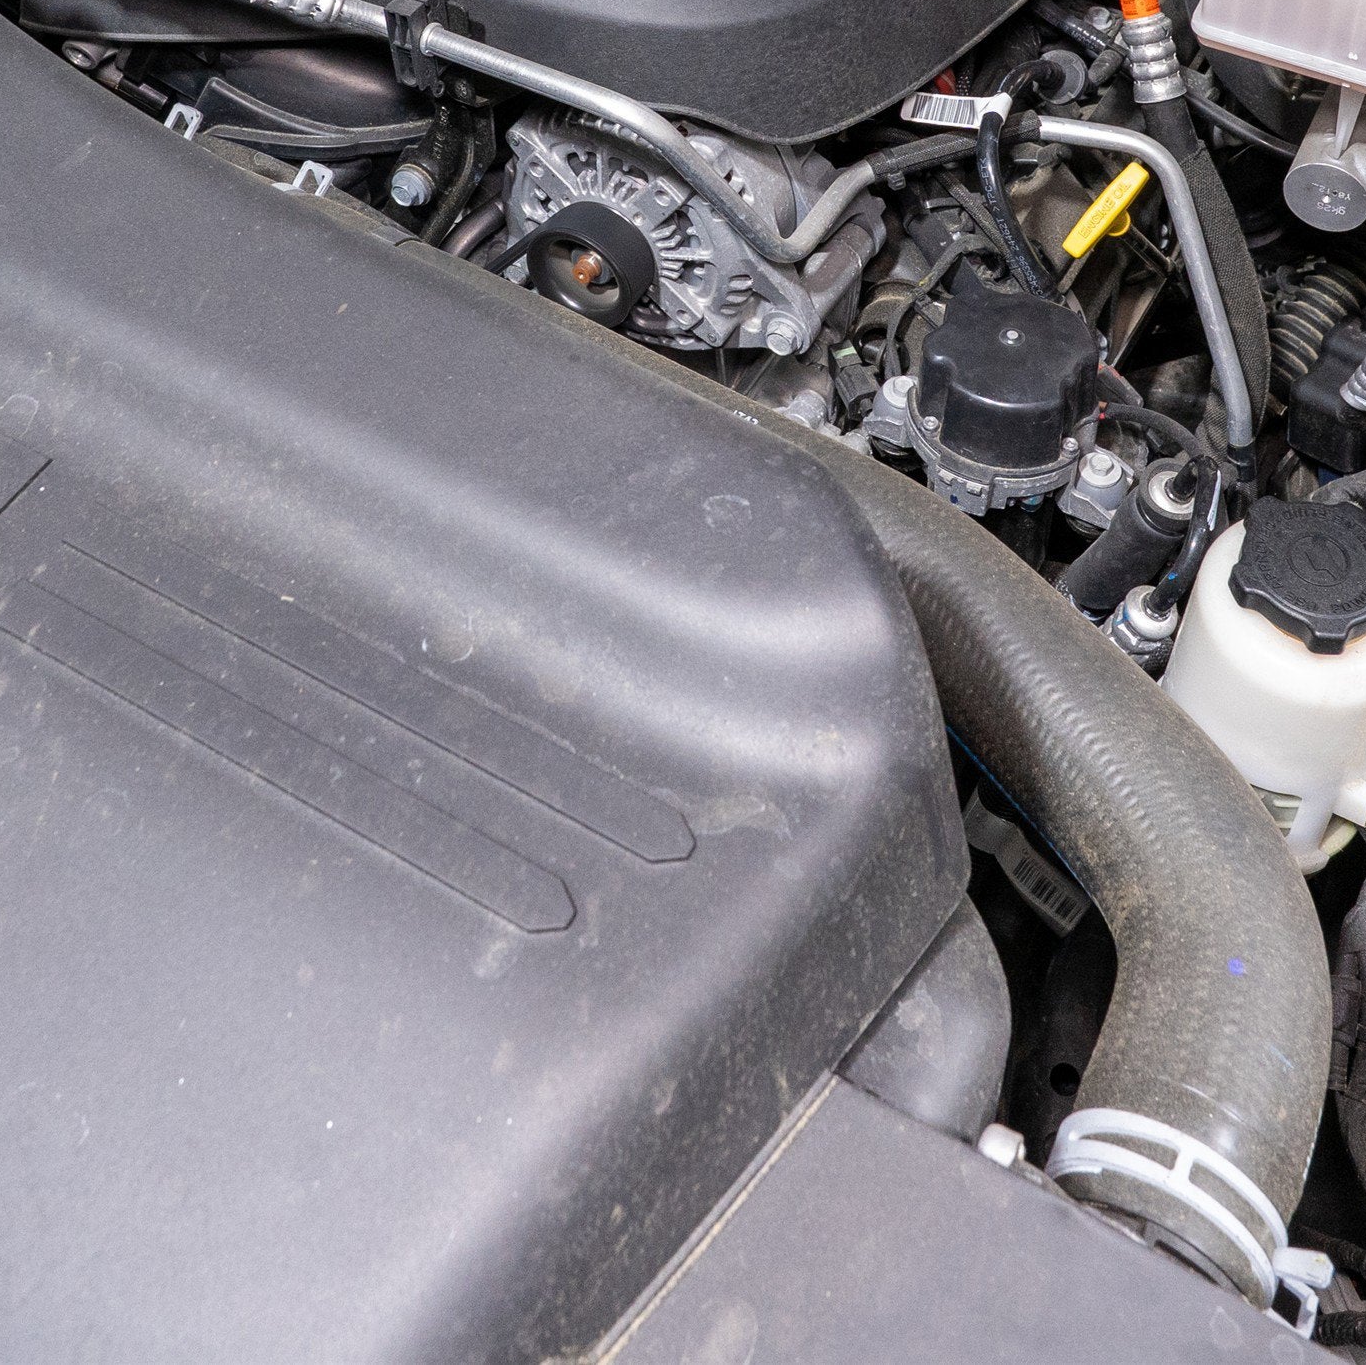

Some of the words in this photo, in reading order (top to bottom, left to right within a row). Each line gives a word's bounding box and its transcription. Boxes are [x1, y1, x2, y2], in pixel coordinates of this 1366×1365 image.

[1076, 196, 1116, 239] ENGINE
[1110, 178, 1132, 200] OIL
[1251, 521, 1284, 590] APPROVED
